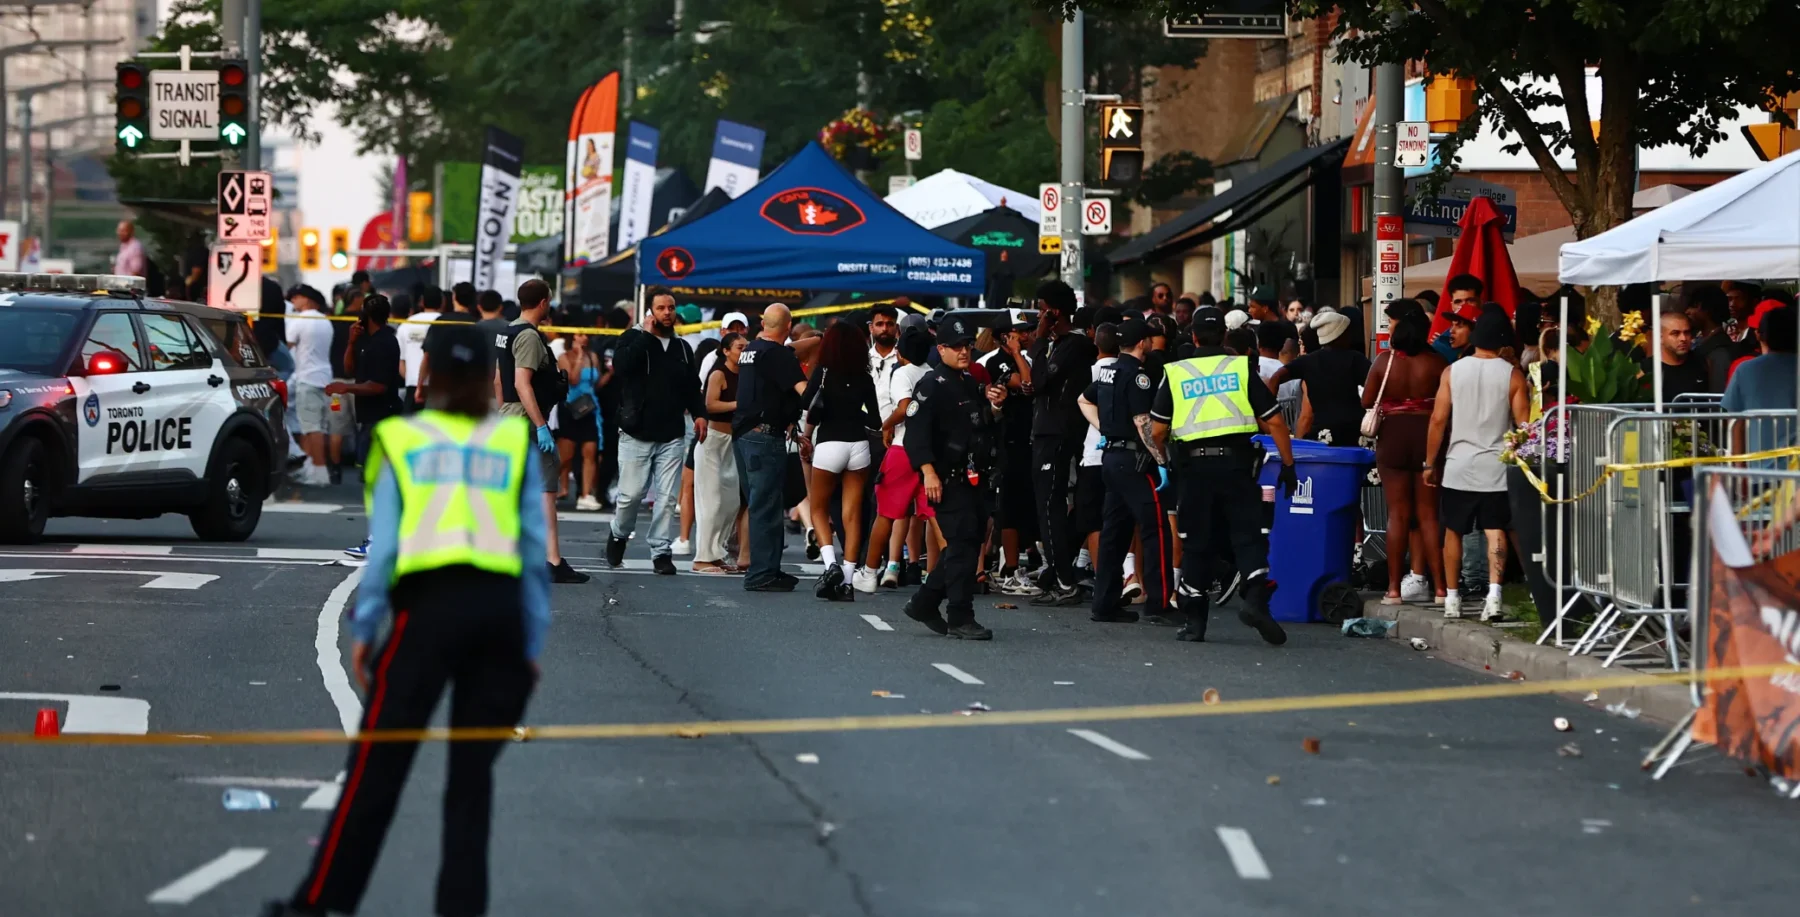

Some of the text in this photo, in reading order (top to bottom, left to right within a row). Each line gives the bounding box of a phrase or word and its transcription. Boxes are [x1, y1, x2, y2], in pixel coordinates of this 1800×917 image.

[155, 82, 217, 102] TRANSIT
[160, 109, 212, 128] SIGNAL
[1407, 126, 1418, 138] NO
[1398, 140, 1427, 152] STANDING
[1411, 200, 1468, 224] Arlingt
[250, 219, 265, 228] THIS
[509, 211, 565, 238] OUR
[247, 229, 266, 238] LANE
[837, 262, 898, 274] ONSITE MEDIC
[1383, 263, 1397, 272] 512
[907, 270, 973, 283] canaphem.ca
[1382, 276, 1394, 284] 312
[236, 383, 271, 400] PSRT17
[1182, 375, 1238, 398] POLICE
[107, 406, 144, 419] TORONTO
[106, 417, 192, 455] POLICE
